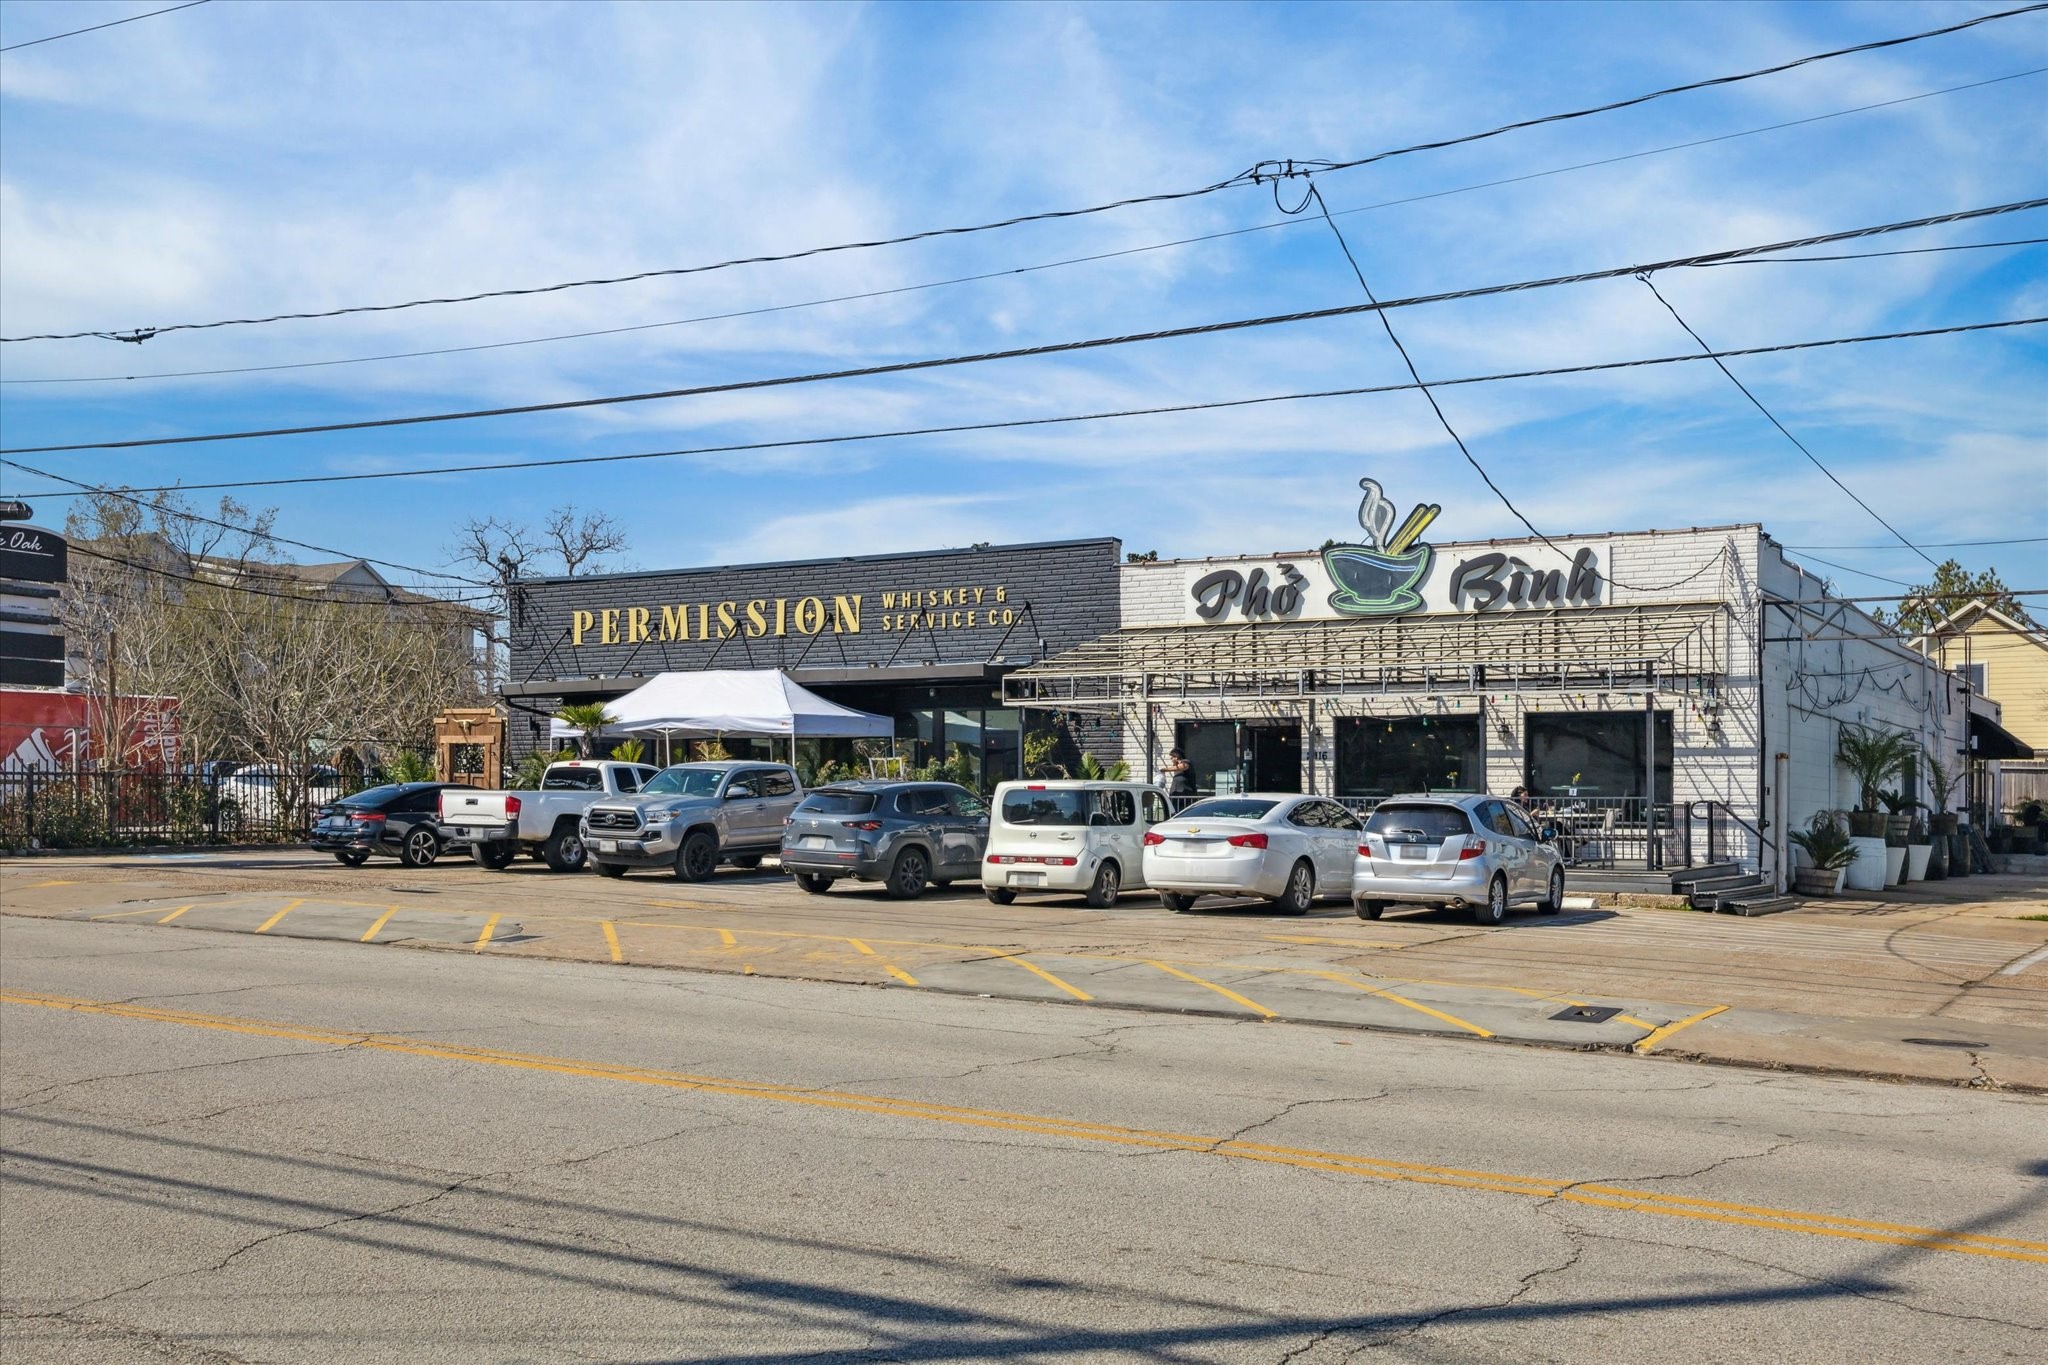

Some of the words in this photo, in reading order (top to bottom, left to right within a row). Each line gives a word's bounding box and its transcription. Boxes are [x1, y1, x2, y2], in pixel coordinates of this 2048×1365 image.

[10, 531, 42, 550] Oak
[1449, 546, 1596, 610] Bình
[882, 587, 985, 609] WHISKEY
[996, 586, 1006, 602] &
[572, 594, 862, 646] PERMISSION
[882, 610, 976, 631] SERVICE
